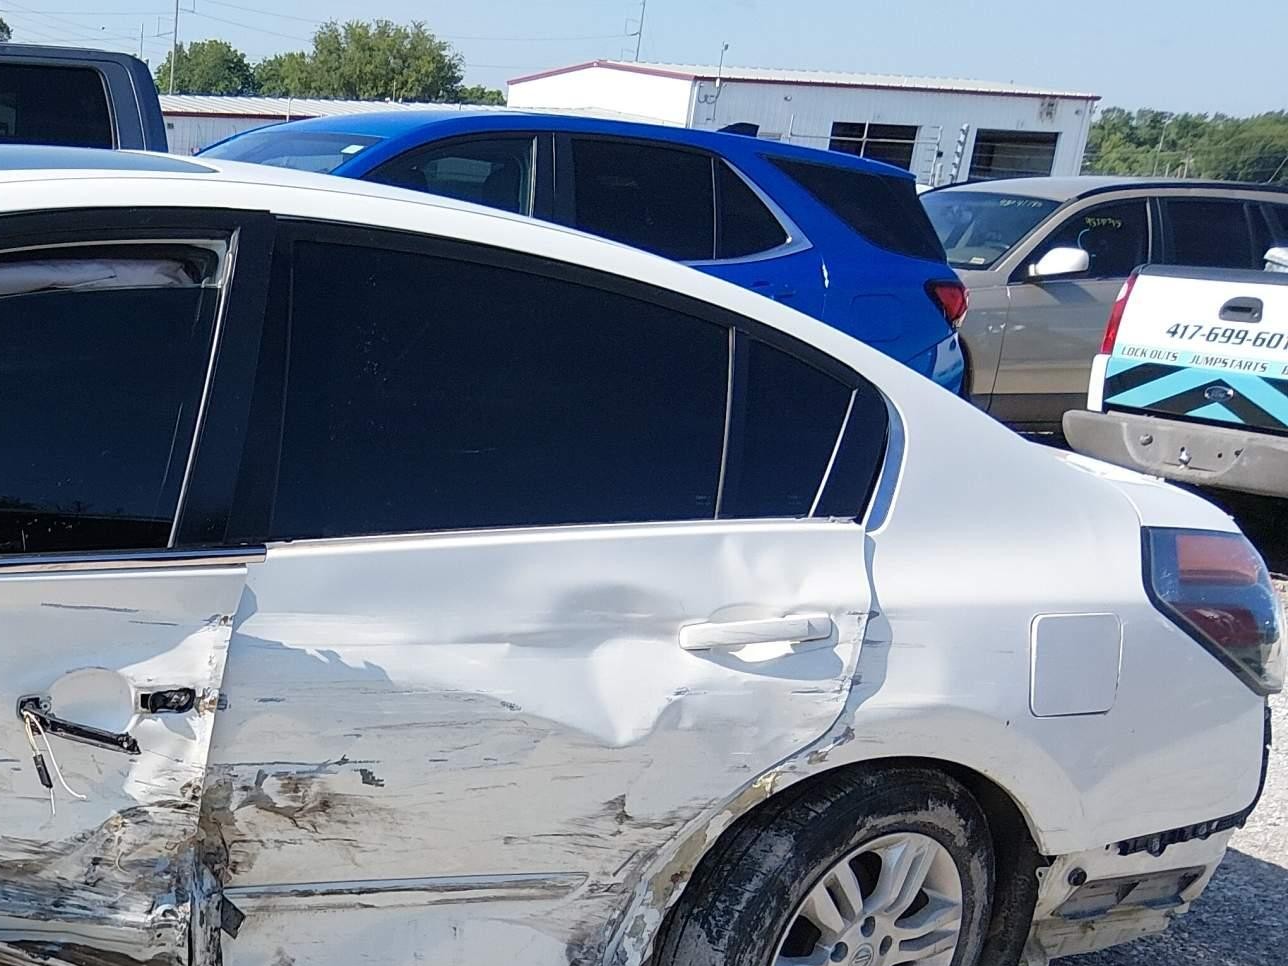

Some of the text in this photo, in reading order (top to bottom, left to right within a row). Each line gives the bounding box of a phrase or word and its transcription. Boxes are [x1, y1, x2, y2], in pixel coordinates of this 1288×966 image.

[1121, 345, 1148, 358] LOCK
[1149, 349, 1179, 362] OUTS
[1189, 354, 1270, 372] JUMPSTARTS
